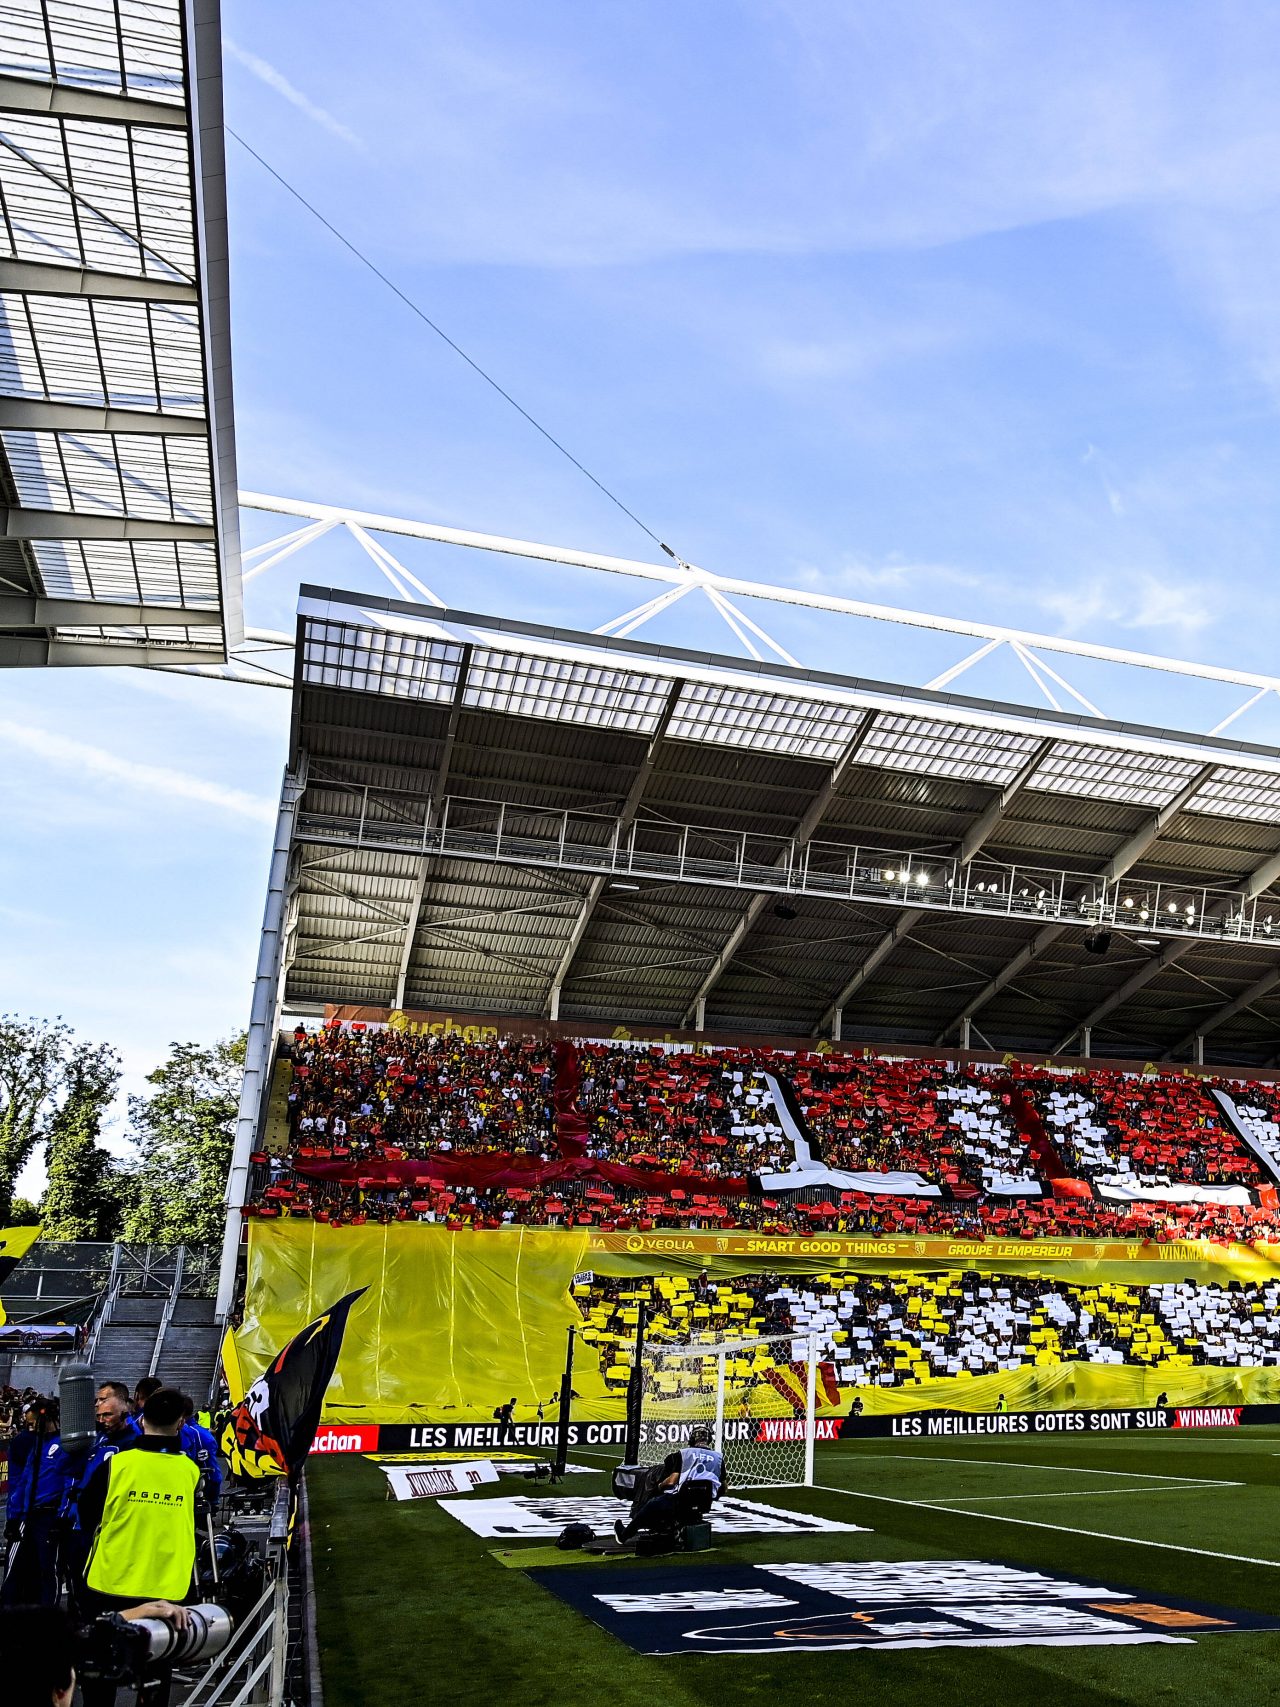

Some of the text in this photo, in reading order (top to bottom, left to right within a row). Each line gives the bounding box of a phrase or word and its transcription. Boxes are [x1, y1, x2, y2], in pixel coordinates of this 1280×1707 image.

[647, 1239, 695, 1250] VEOLIA
[747, 1240, 896, 1253] SMART GOOD THINGS
[948, 1244, 1072, 1257] GROUPE LEMPEREUR
[1159, 1246, 1208, 1260] WINAMAX
[892, 1408, 1237, 1436] LES MEILLEURES COTES SONT SUR WINAMAX
[410, 1426, 447, 1448] LES
[764, 1420, 835, 1440] WINAAX
[309, 1430, 362, 1452] uchan
[692, 1452, 715, 1463] LFP
[407, 1471, 457, 1497] WINAMAX
[128, 1490, 184, 1503] AGORA
